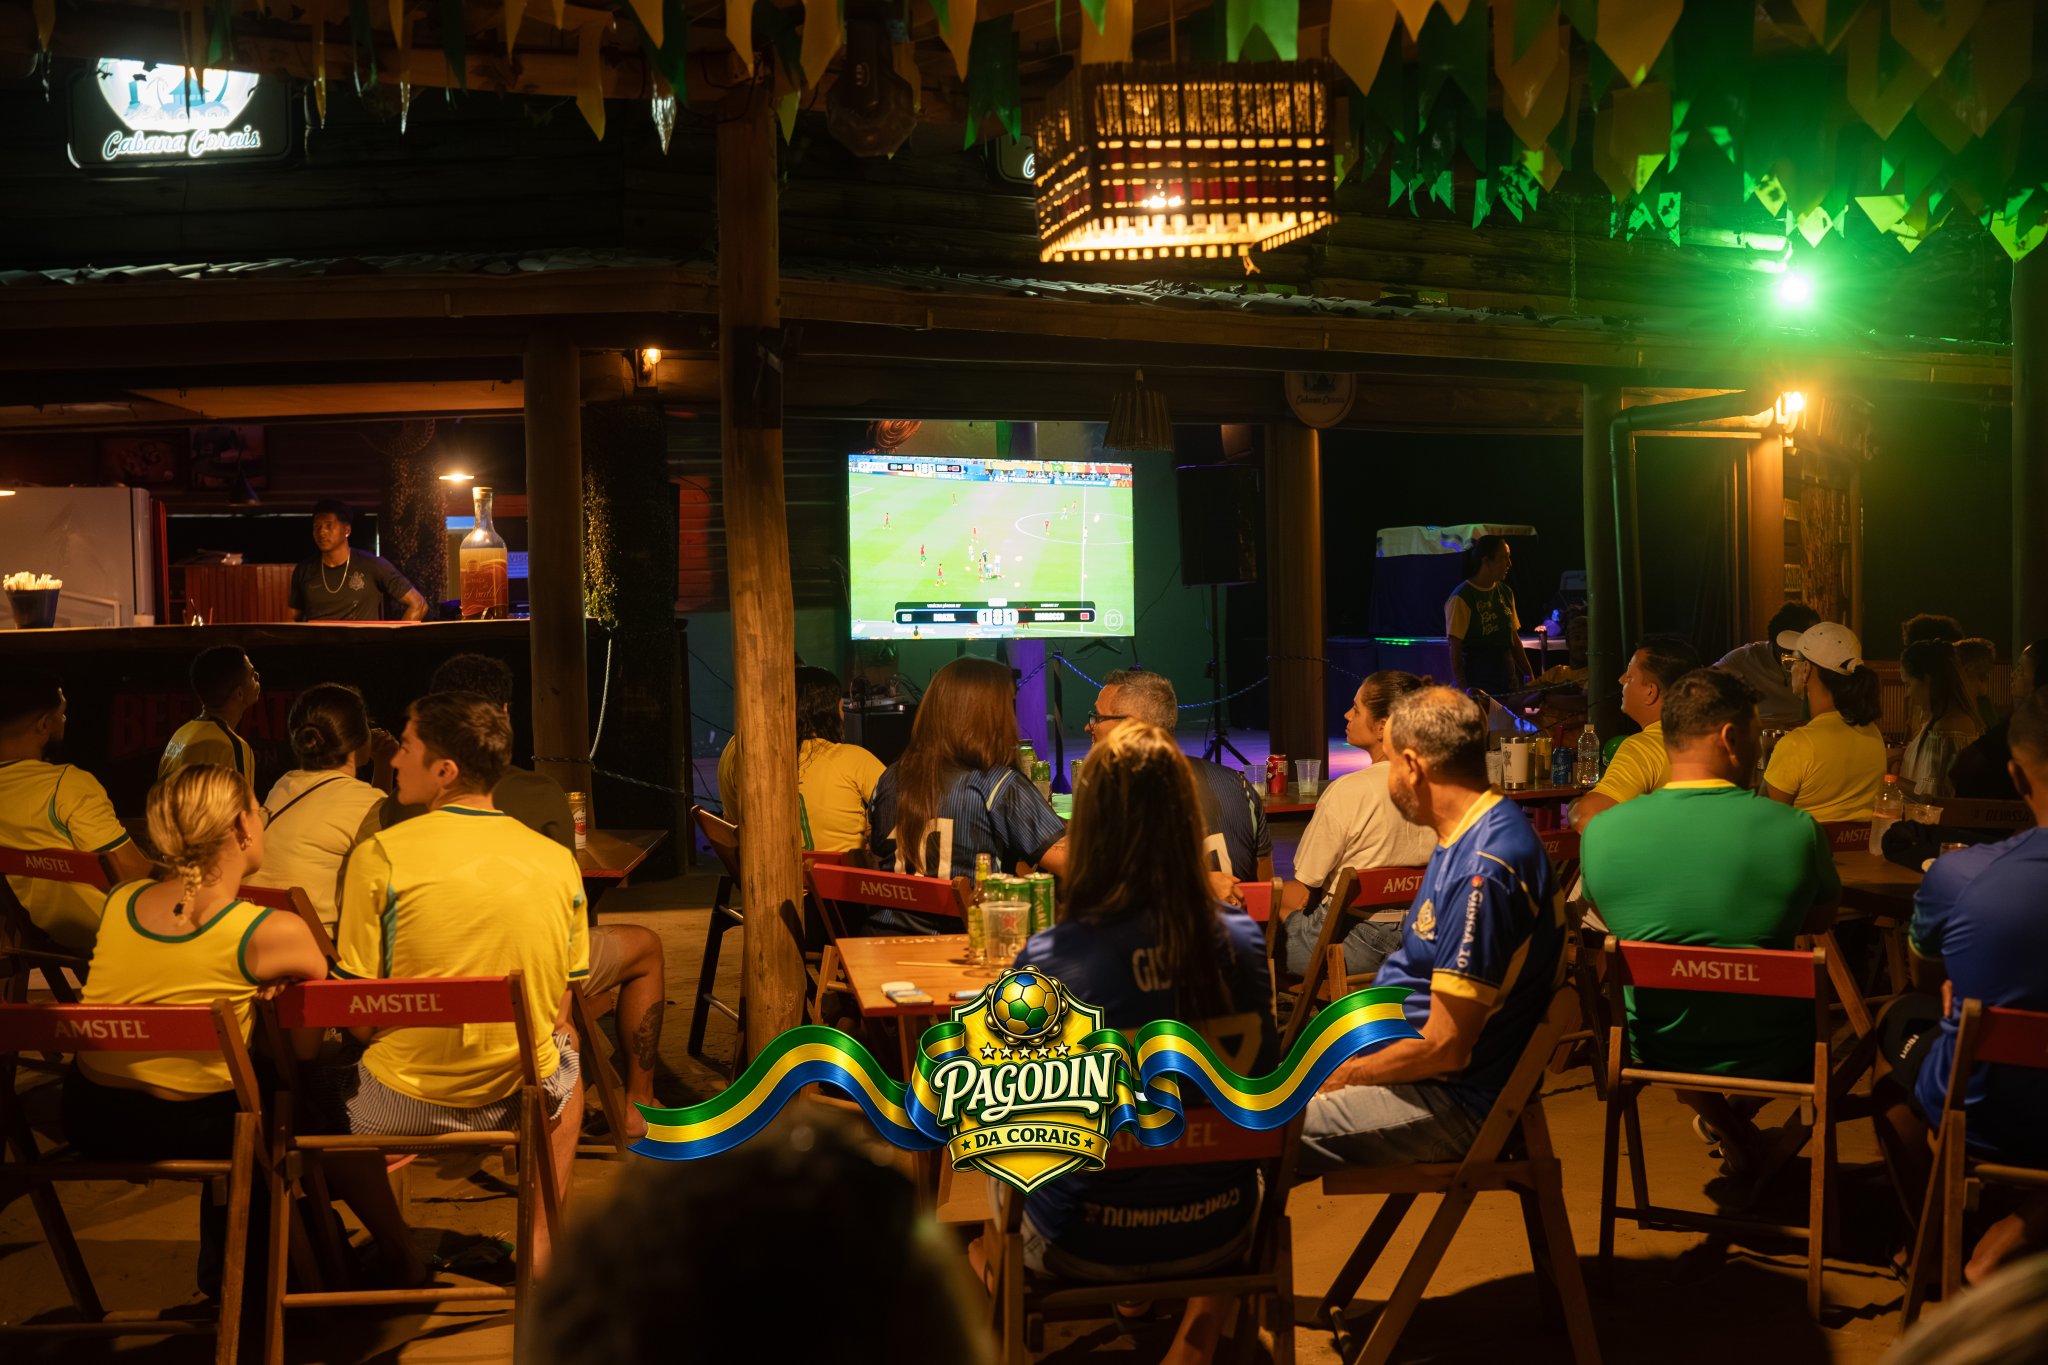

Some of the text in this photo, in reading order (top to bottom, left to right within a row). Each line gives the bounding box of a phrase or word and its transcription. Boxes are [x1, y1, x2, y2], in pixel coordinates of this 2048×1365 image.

[103, 125, 261, 160] Cabana Corais
[1834, 828, 1872, 844] AMSTE
[24, 855, 75, 874] AMSTEL
[860, 880, 918, 902] AMSTEL
[1382, 875, 1425, 894] AMST
[1671, 959, 1760, 982] AMSTEL
[349, 993, 444, 1014] AMSTEL
[55, 1019, 150, 1039] AMSTEL
